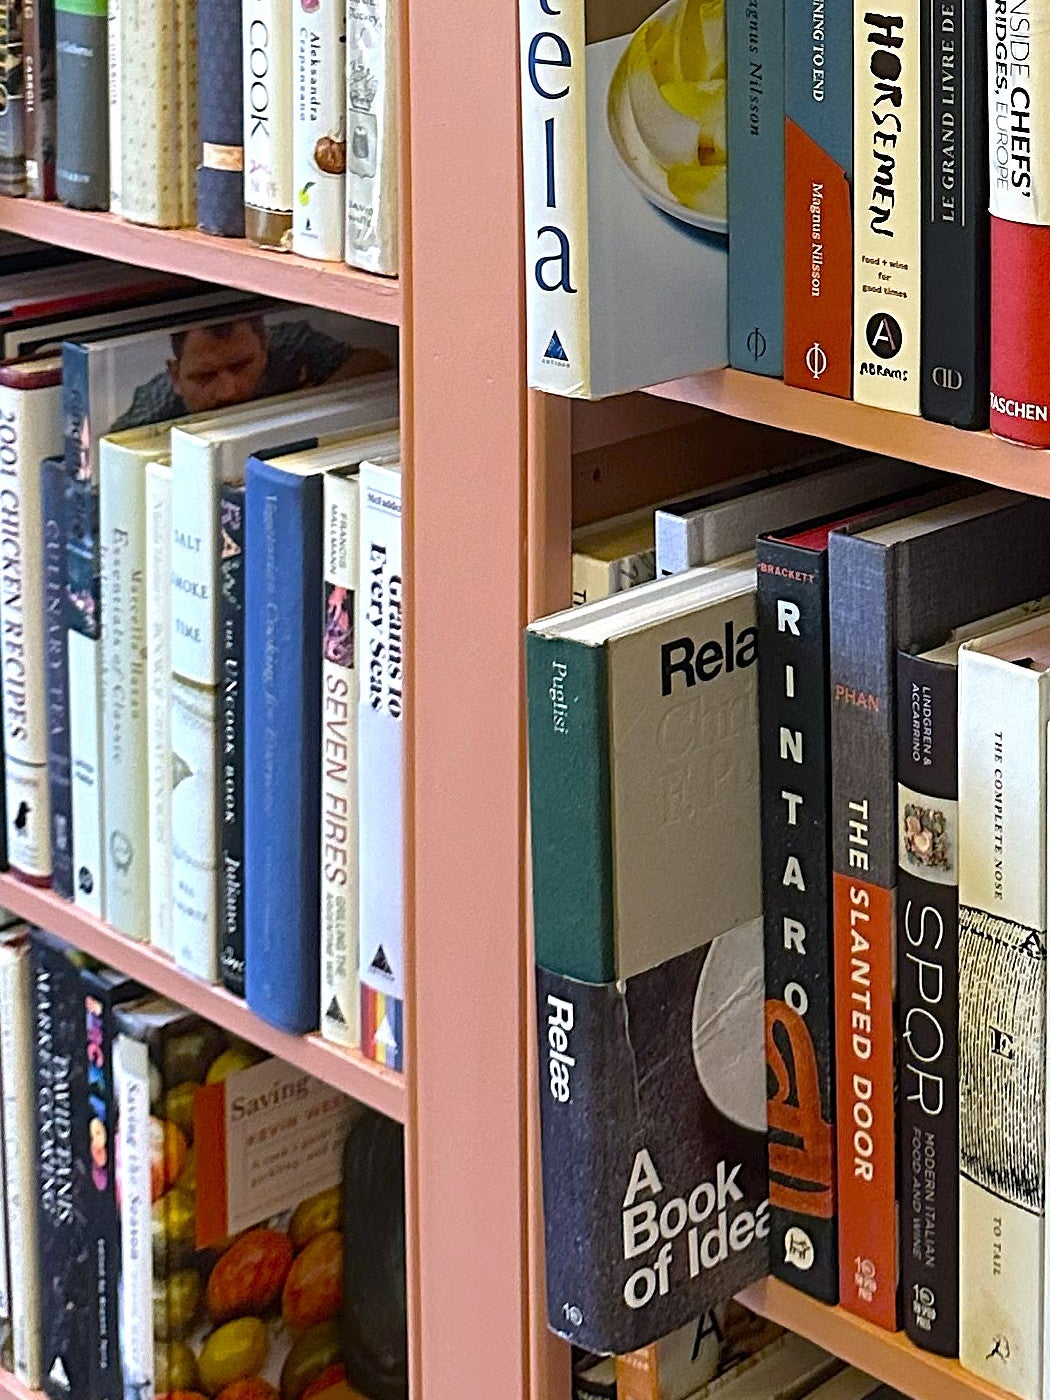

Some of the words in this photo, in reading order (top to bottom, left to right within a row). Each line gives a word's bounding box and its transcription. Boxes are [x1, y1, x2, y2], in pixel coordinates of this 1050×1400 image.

[942, 4, 954, 32] DE
[250, 20, 269, 137] COOK
[942, 40, 955, 105] LIVRE
[863, 12, 903, 237] HORSEMEN
[942, 112, 955, 190] GRAND
[942, 196, 954, 222] LE
[326, 675, 348, 783] SEVEN
[834, 684, 880, 712] PHAN
[325, 793, 348, 885] FIRES
[777, 600, 812, 1016] RINTARO
[848, 800, 869, 872] THE
[849, 886, 872, 1061] SLANTED
[903, 901, 944, 1116] SPQR
[853, 1073, 874, 1181] DOOR
[622, 1160, 744, 1260] Book
